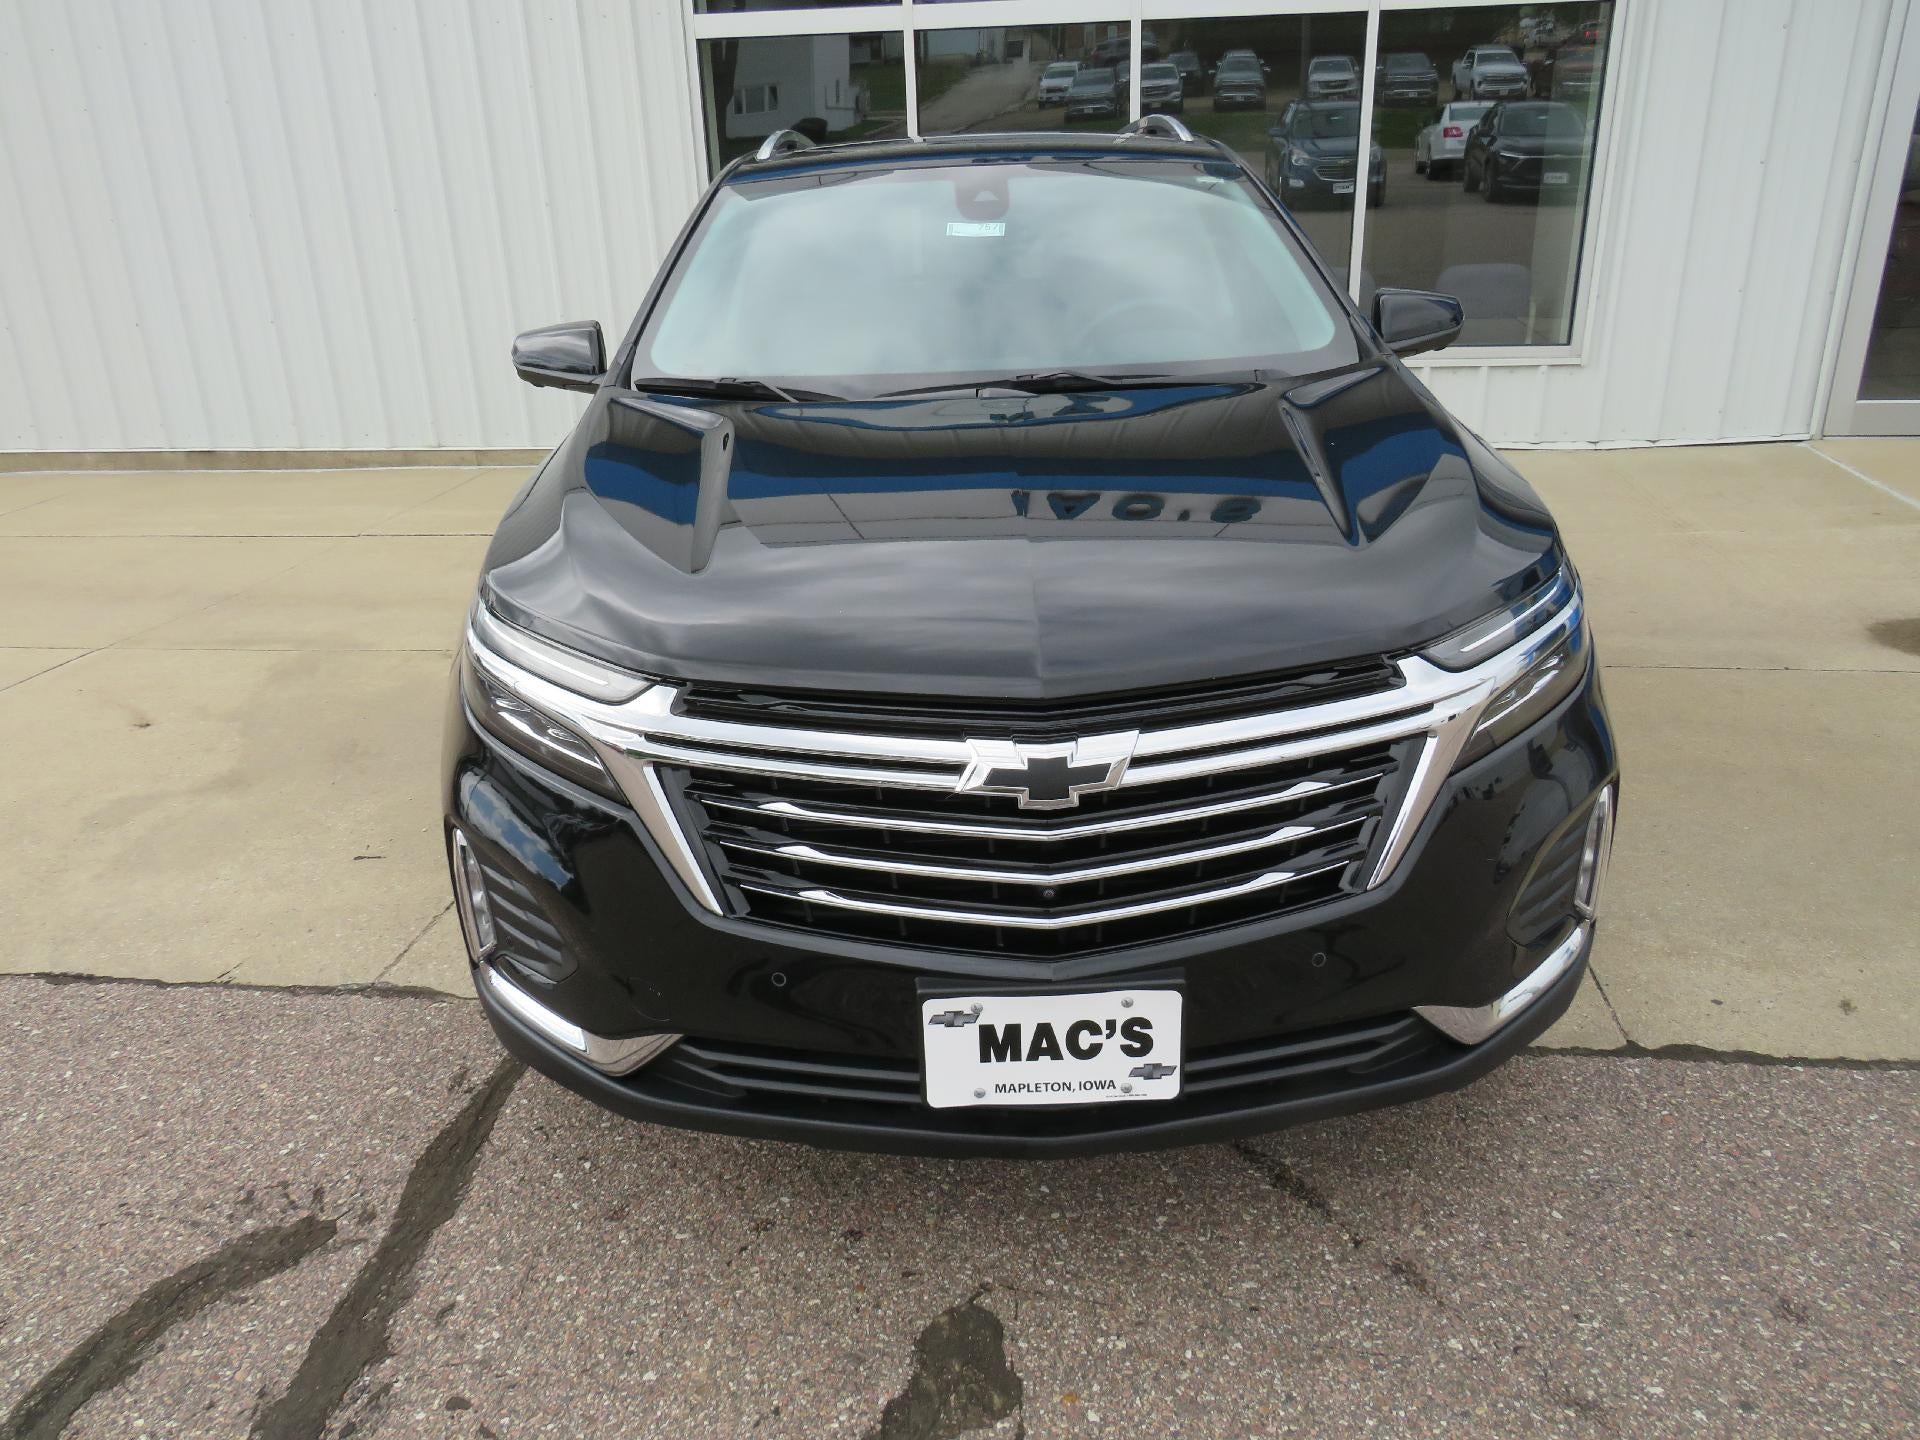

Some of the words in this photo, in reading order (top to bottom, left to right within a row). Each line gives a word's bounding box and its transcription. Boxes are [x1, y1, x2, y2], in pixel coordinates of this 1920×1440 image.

[978, 1016, 1154, 1063] MAC'S
[994, 1081, 1076, 1094] MAPLETON,
[1078, 1079, 1117, 1091] IOWA
